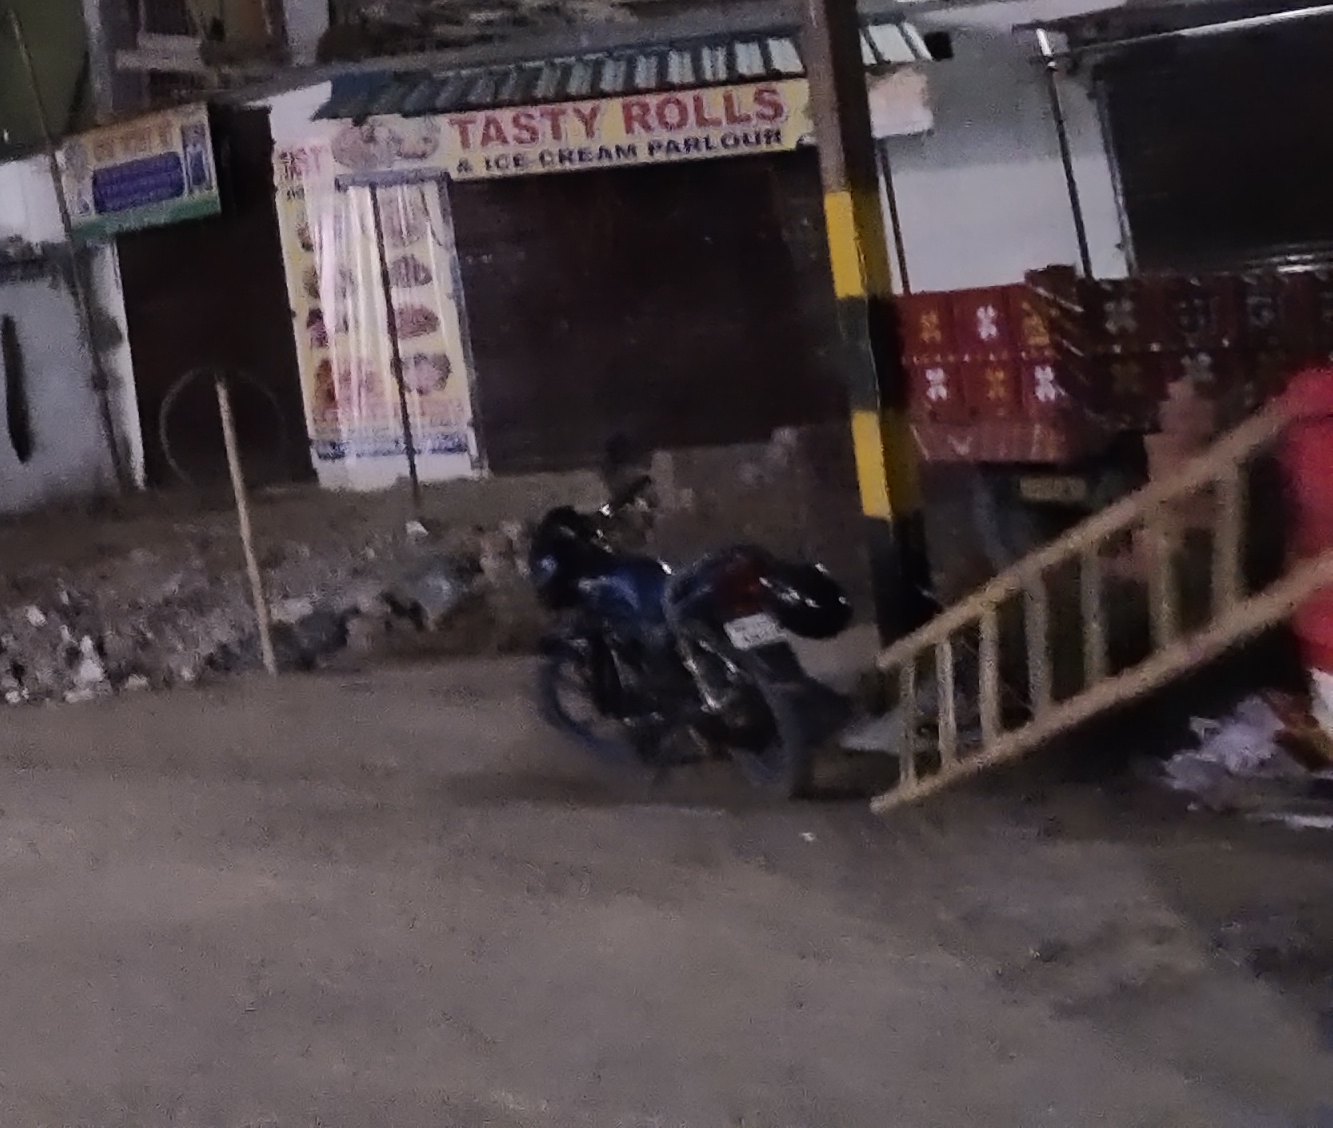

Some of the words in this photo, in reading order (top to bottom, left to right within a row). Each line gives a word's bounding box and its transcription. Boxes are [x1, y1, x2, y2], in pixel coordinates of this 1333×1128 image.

[447, 102, 602, 151] TASTY
[621, 84, 785, 136] ROLLS
[455, 157, 474, 175] &
[647, 127, 783, 158] PARLOUR
